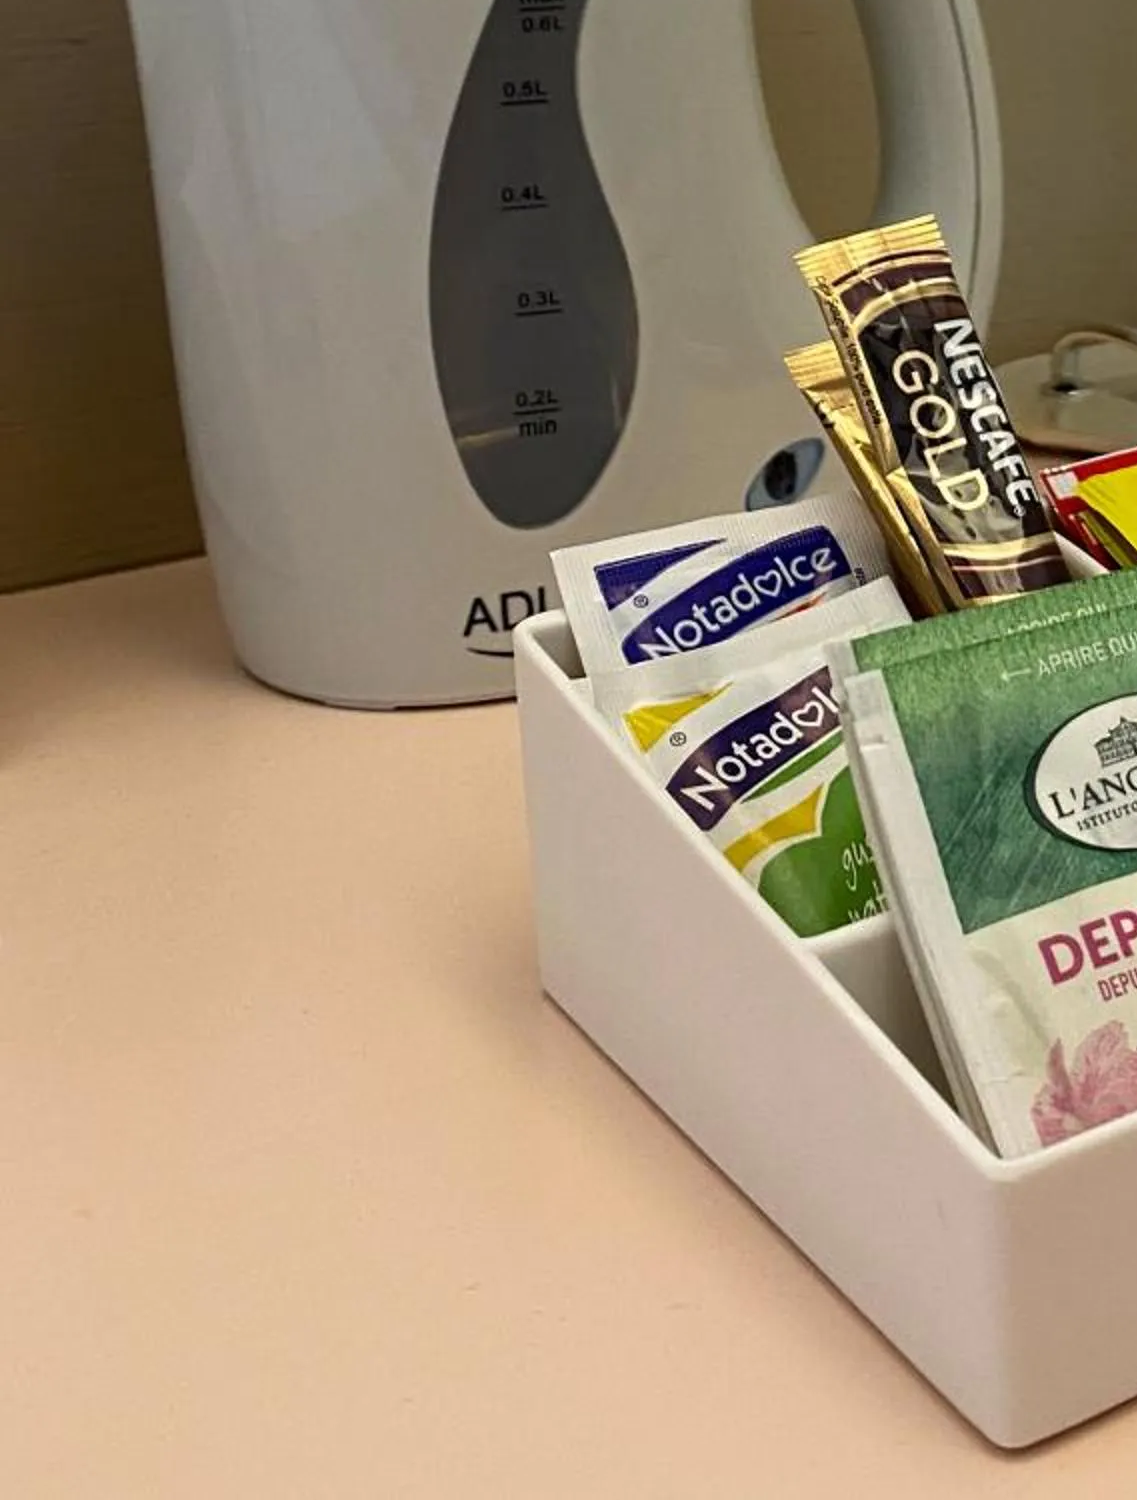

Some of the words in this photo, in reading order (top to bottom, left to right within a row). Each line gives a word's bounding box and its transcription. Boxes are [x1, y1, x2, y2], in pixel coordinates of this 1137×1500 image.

[521, 16, 565, 33] 0.6L
[502, 80, 548, 98] 0.5L
[501, 184, 546, 202] 0.4L
[517, 290, 561, 308] 0.3L
[514, 390, 559, 408] 0.2L
[518, 417, 557, 436] min
[892, 349, 989, 511] GOLD
[1038, 641, 1109, 677] APRIRE
[680, 686, 840, 812] Notadol
